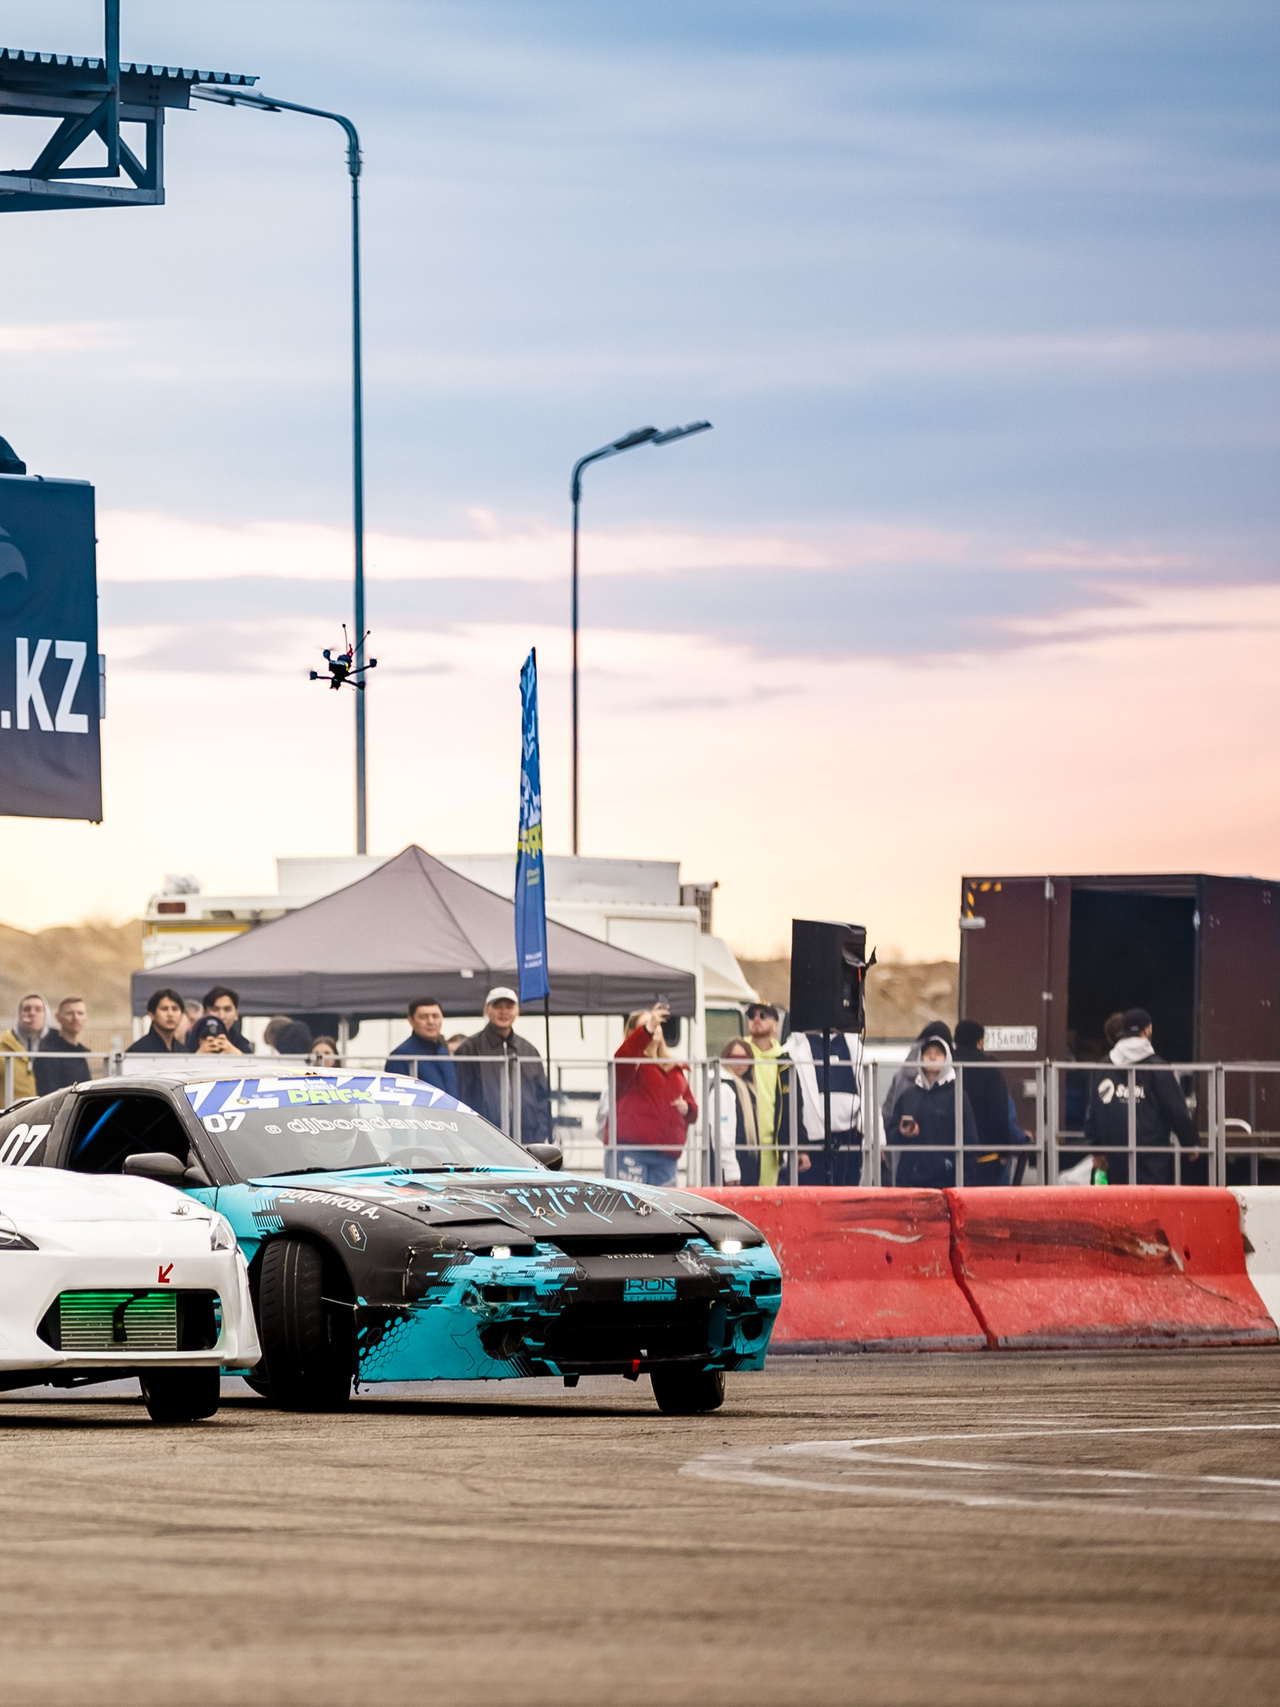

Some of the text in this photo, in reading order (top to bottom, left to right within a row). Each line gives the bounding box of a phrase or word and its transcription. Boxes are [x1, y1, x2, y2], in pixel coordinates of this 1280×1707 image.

[203, 1112, 246, 1134] 07
[287, 1117, 458, 1134] djbogdanov
[278, 1190, 365, 1212] БОГДАНОВ
[624, 1278, 677, 1292] IRON
